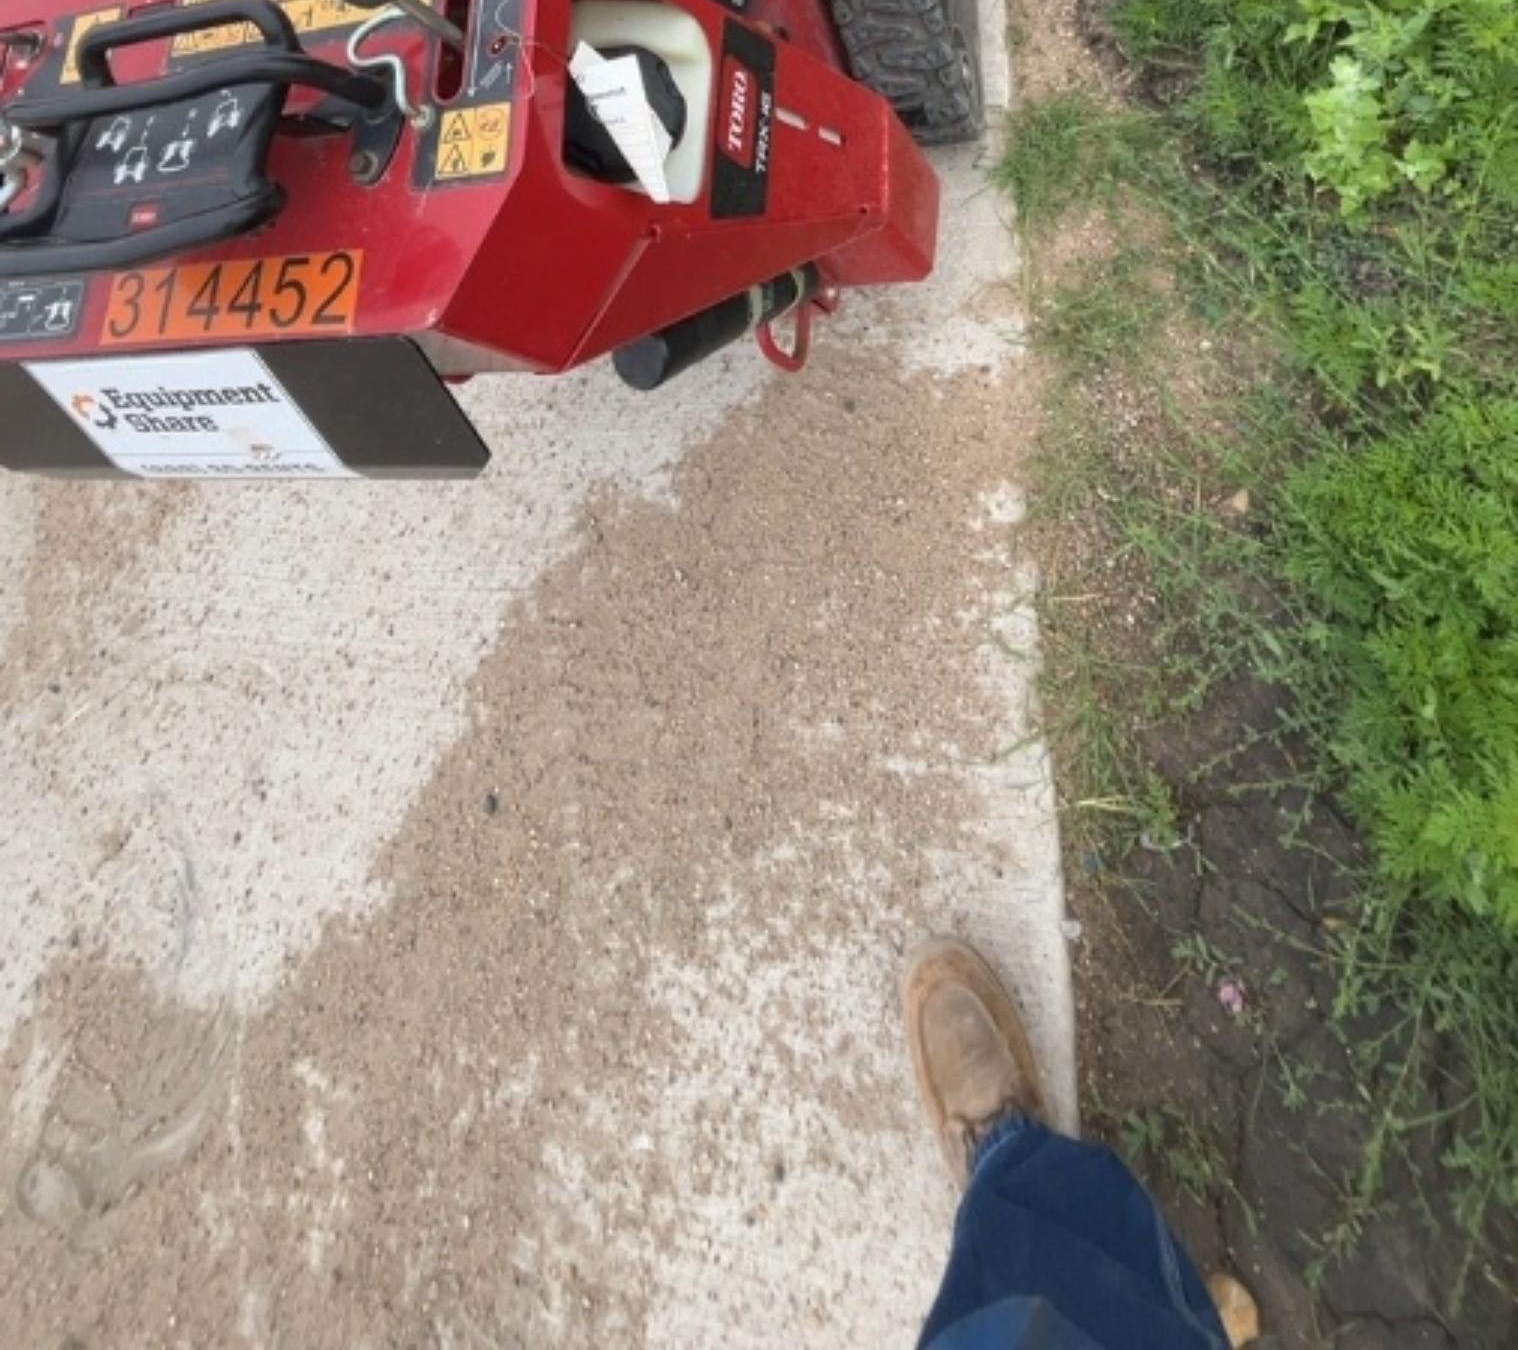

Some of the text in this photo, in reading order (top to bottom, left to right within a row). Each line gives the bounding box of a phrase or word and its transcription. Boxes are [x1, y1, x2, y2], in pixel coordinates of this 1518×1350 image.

[728, 70, 748, 152] TORO
[109, 252, 354, 338] 314452
[101, 382, 281, 411] Equipment
[123, 413, 219, 433] Share
